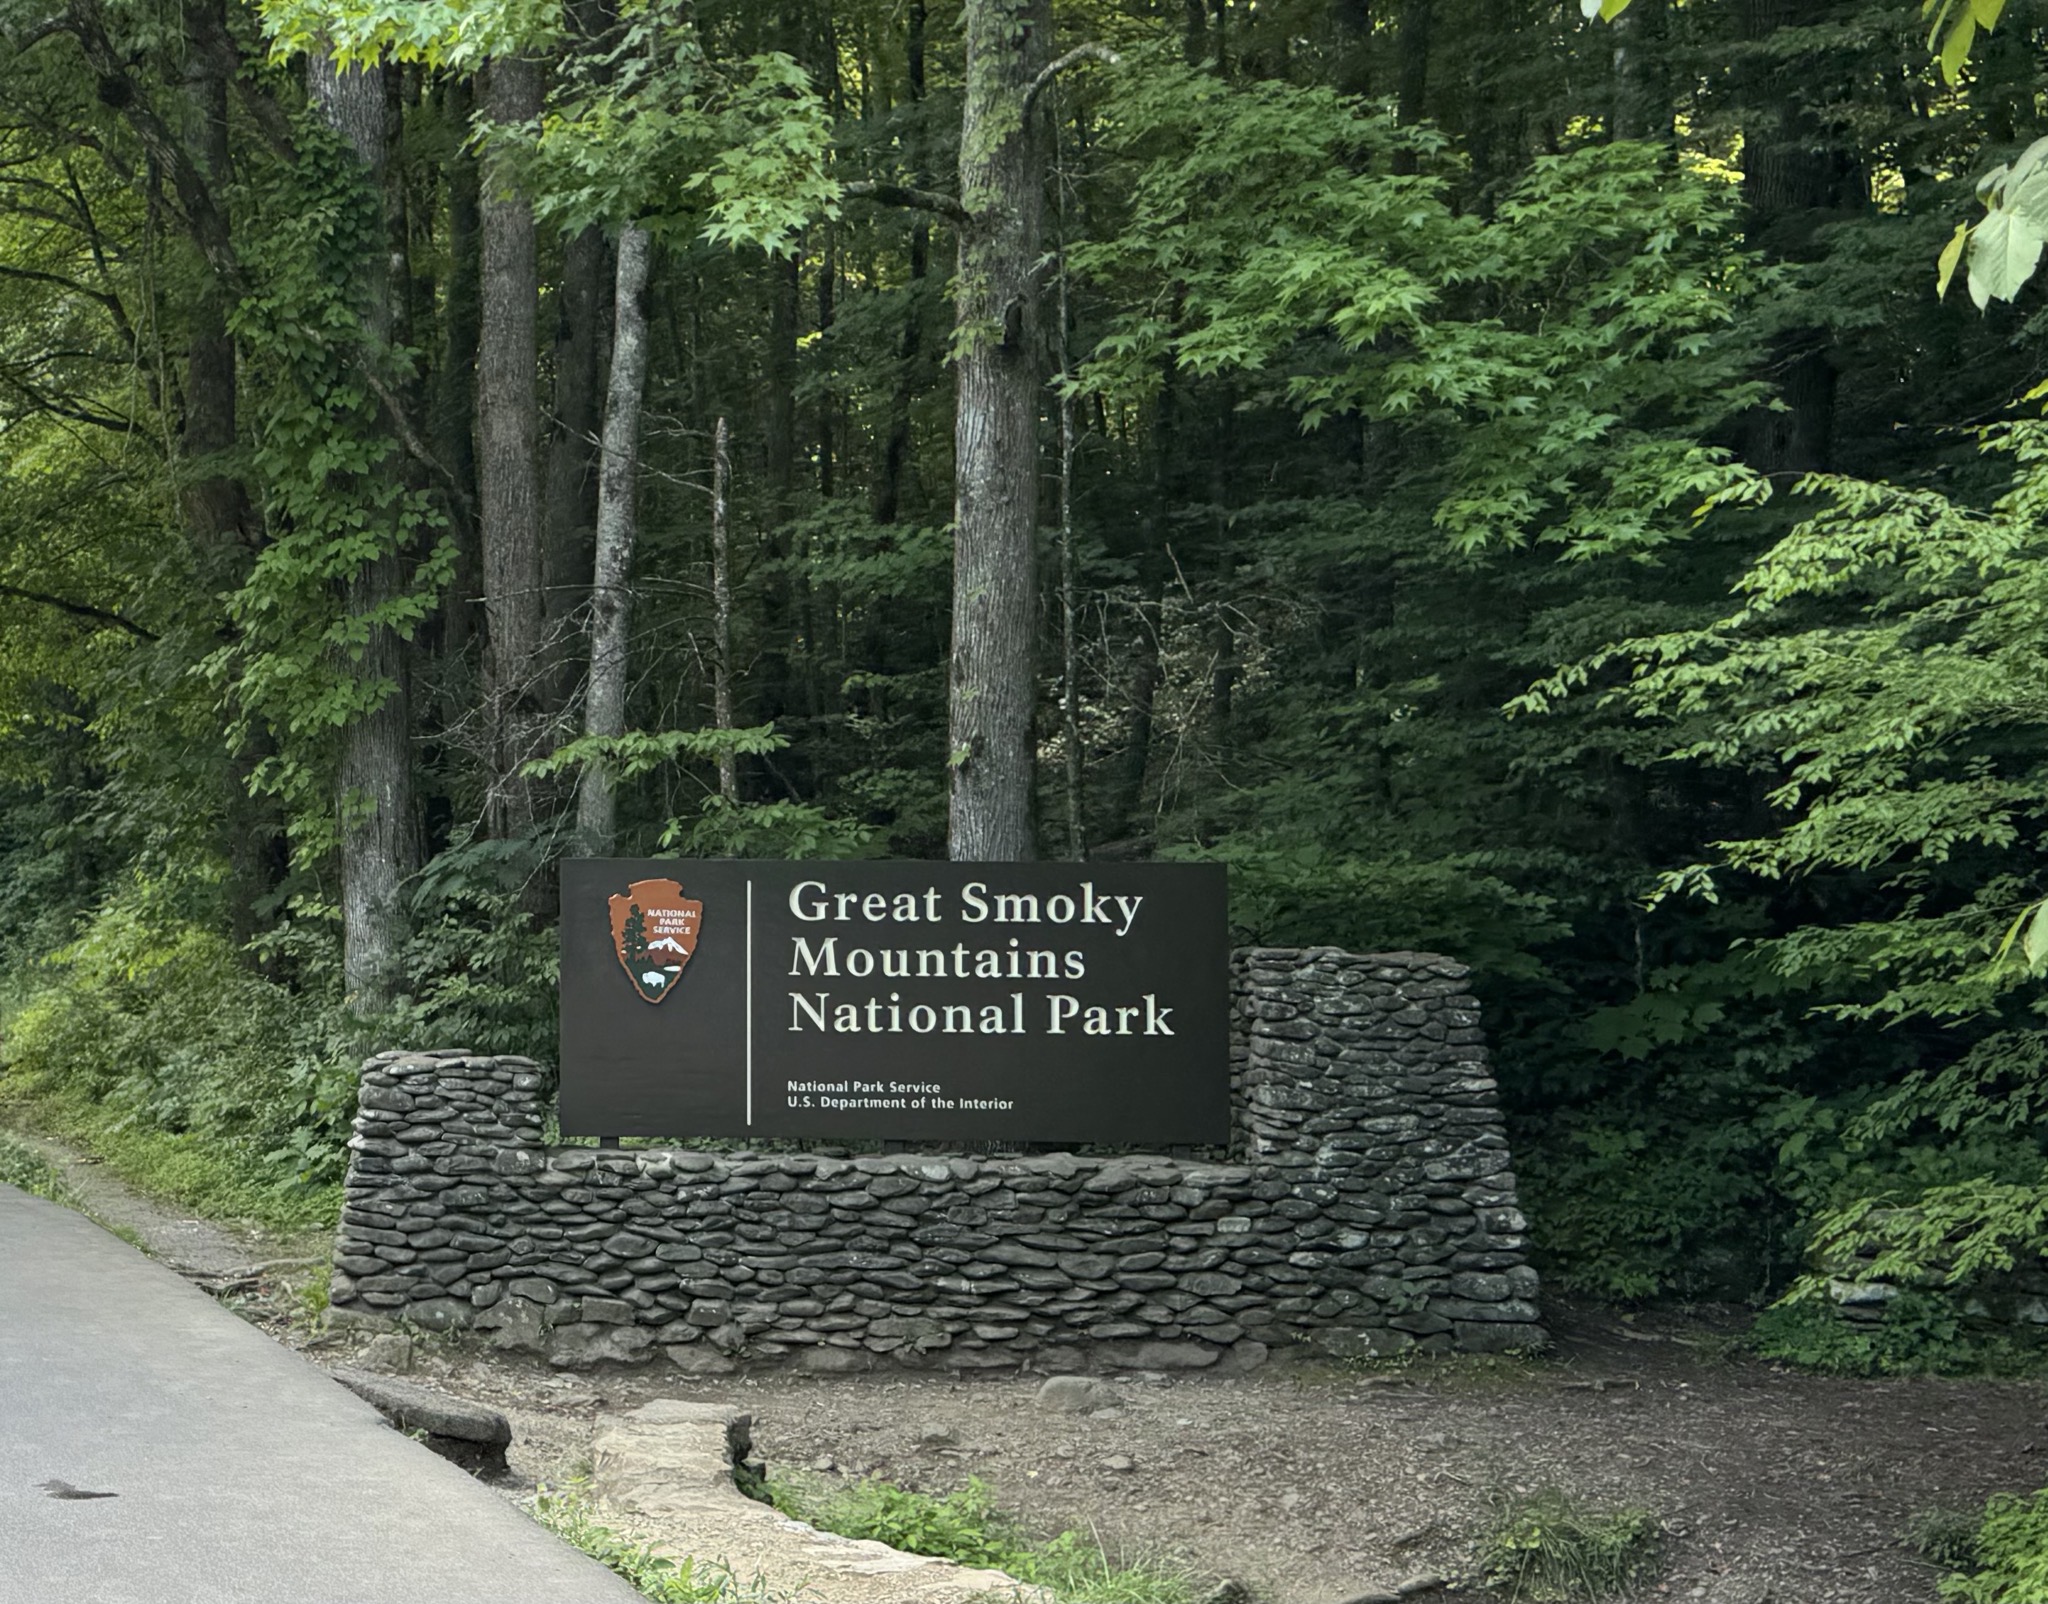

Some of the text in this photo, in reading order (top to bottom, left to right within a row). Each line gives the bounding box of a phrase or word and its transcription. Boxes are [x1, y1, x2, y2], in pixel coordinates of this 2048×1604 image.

[647, 908, 696, 918] NATIONAL
[788, 880, 1144, 937] Great Smoky
[659, 918, 685, 926] PARK
[652, 926, 691, 935] SERVICE
[787, 936, 1086, 980] Mountains
[787, 991, 1175, 1036] National Park
[787, 1080, 941, 1094] National Park Service
[787, 1095, 1014, 1111] U.S. Department of the Interior
